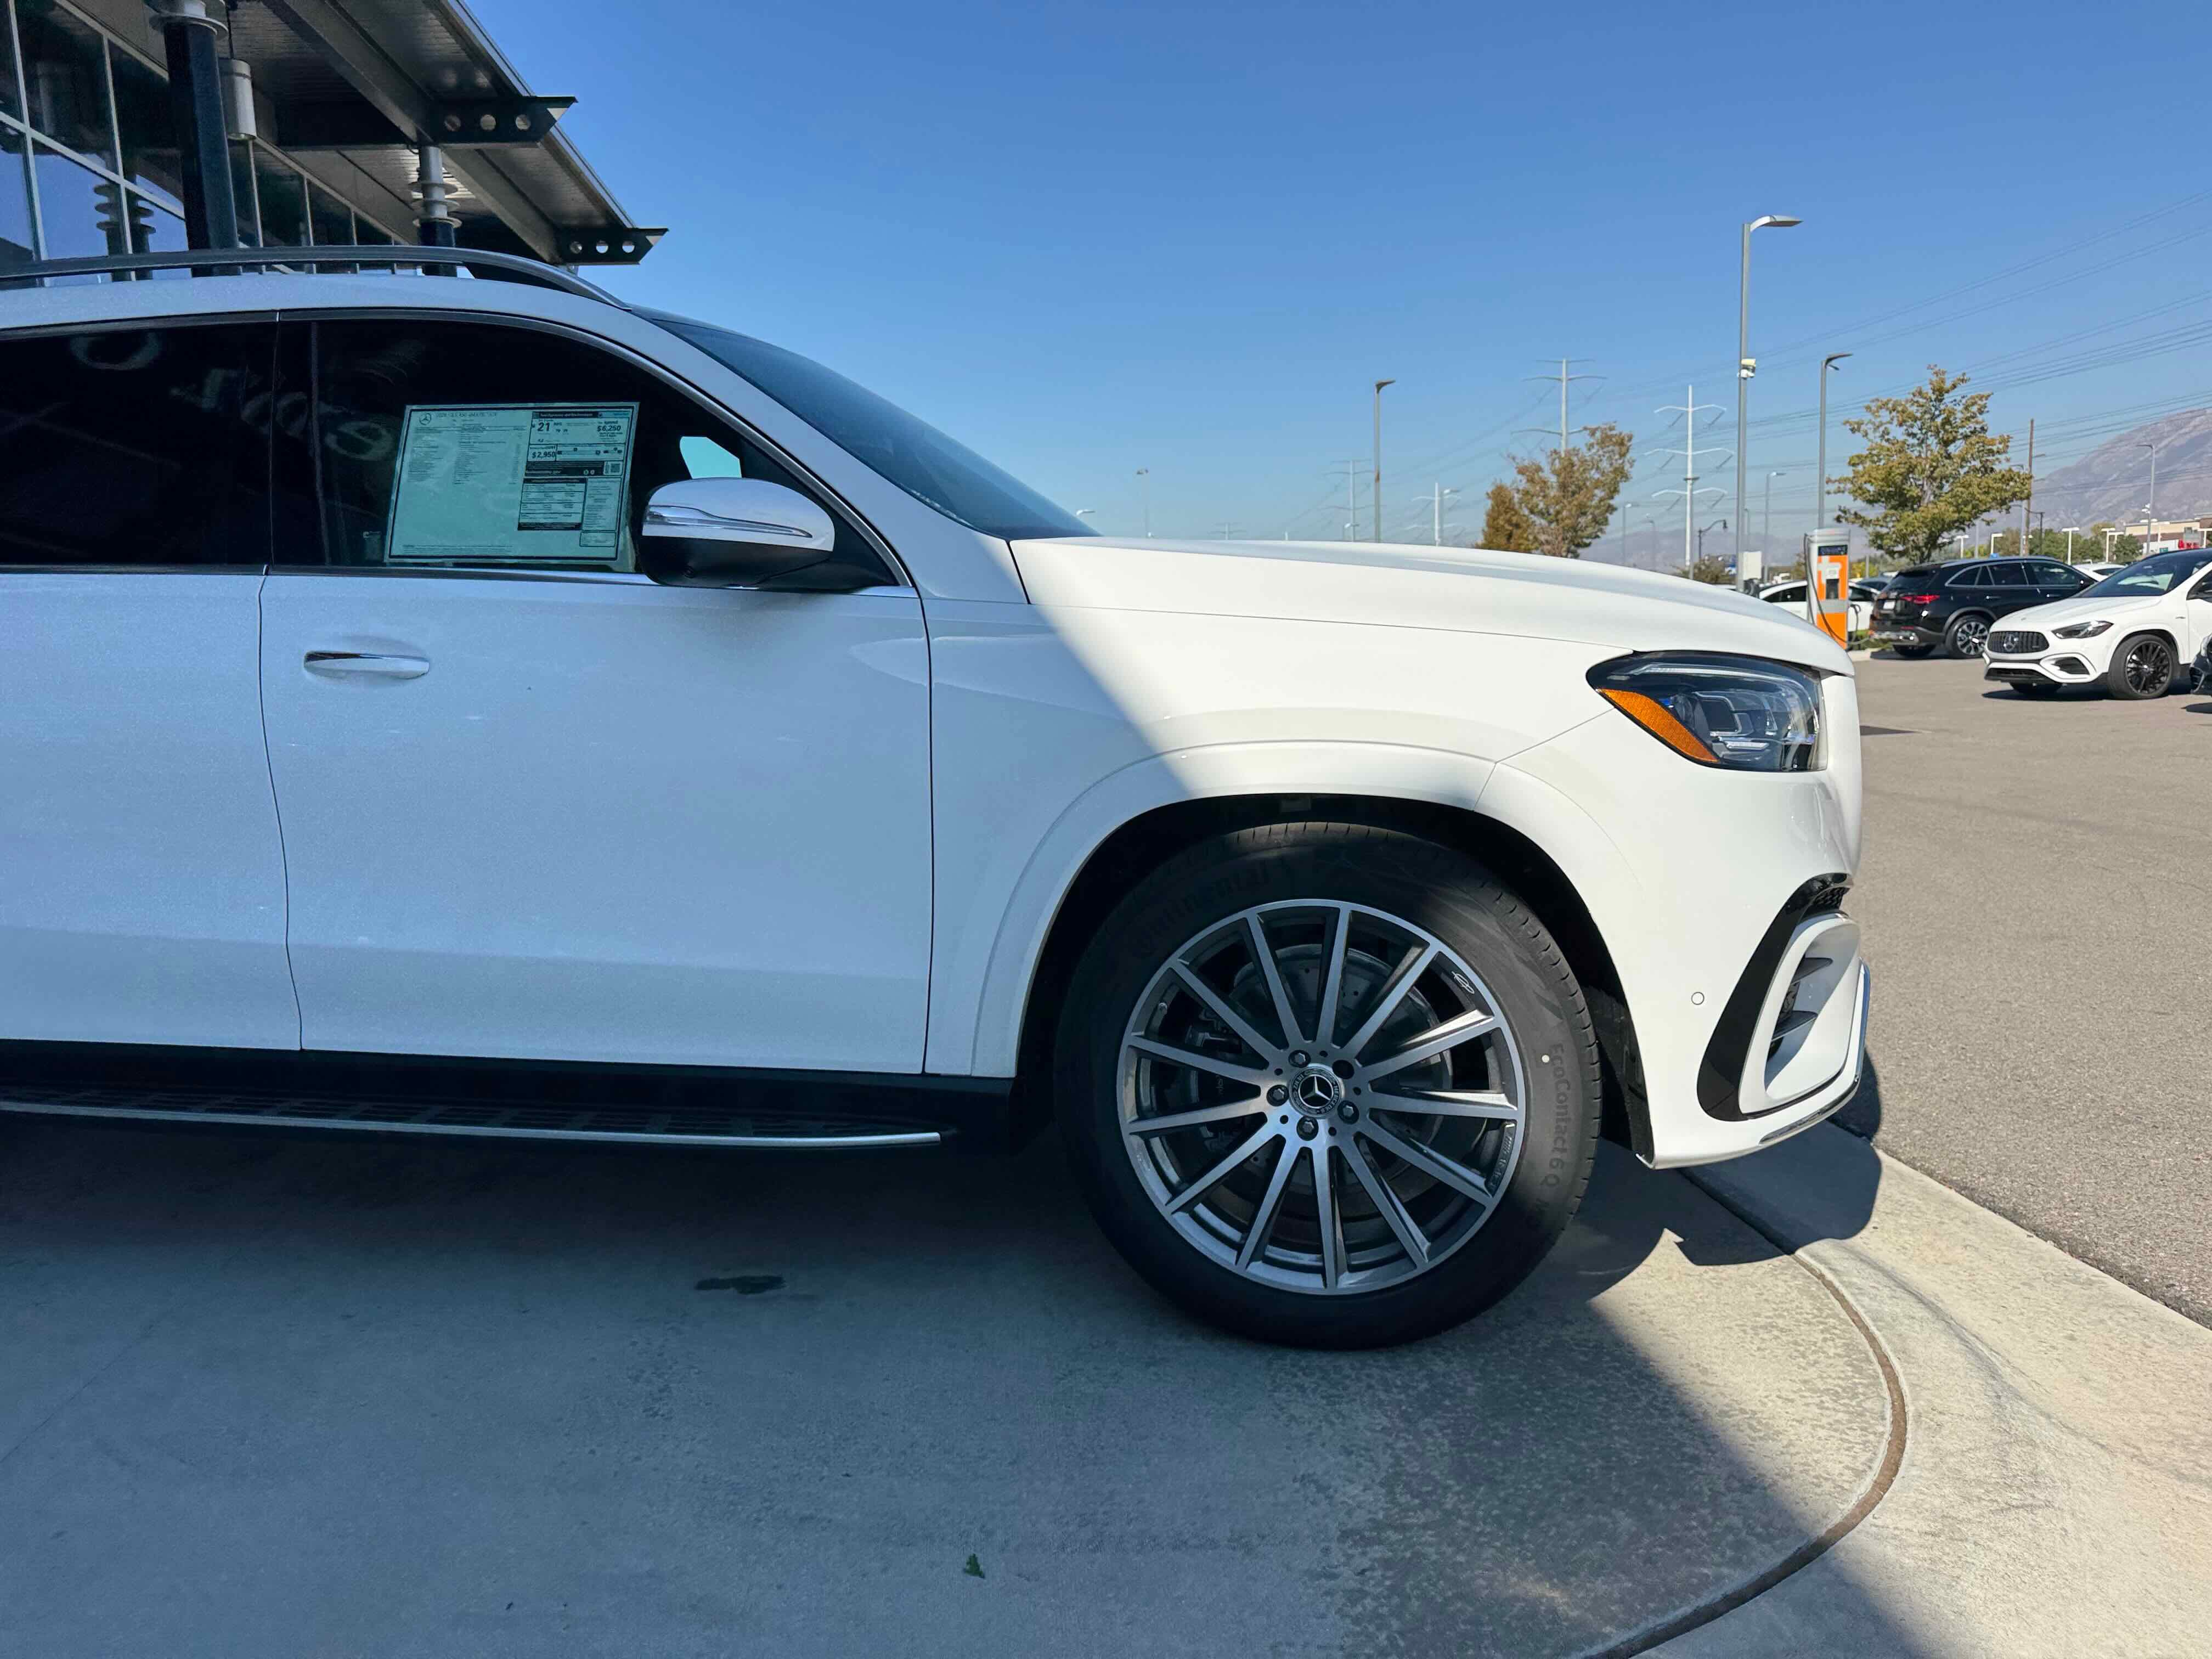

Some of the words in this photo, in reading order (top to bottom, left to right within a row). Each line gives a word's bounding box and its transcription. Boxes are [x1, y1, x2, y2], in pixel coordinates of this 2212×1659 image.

[537, 422, 550, 432] 21
[1549, 1042, 1572, 1154] EcoContact
[1549, 1157, 1564, 1169] 6
[1540, 1173, 1560, 1187] Q
